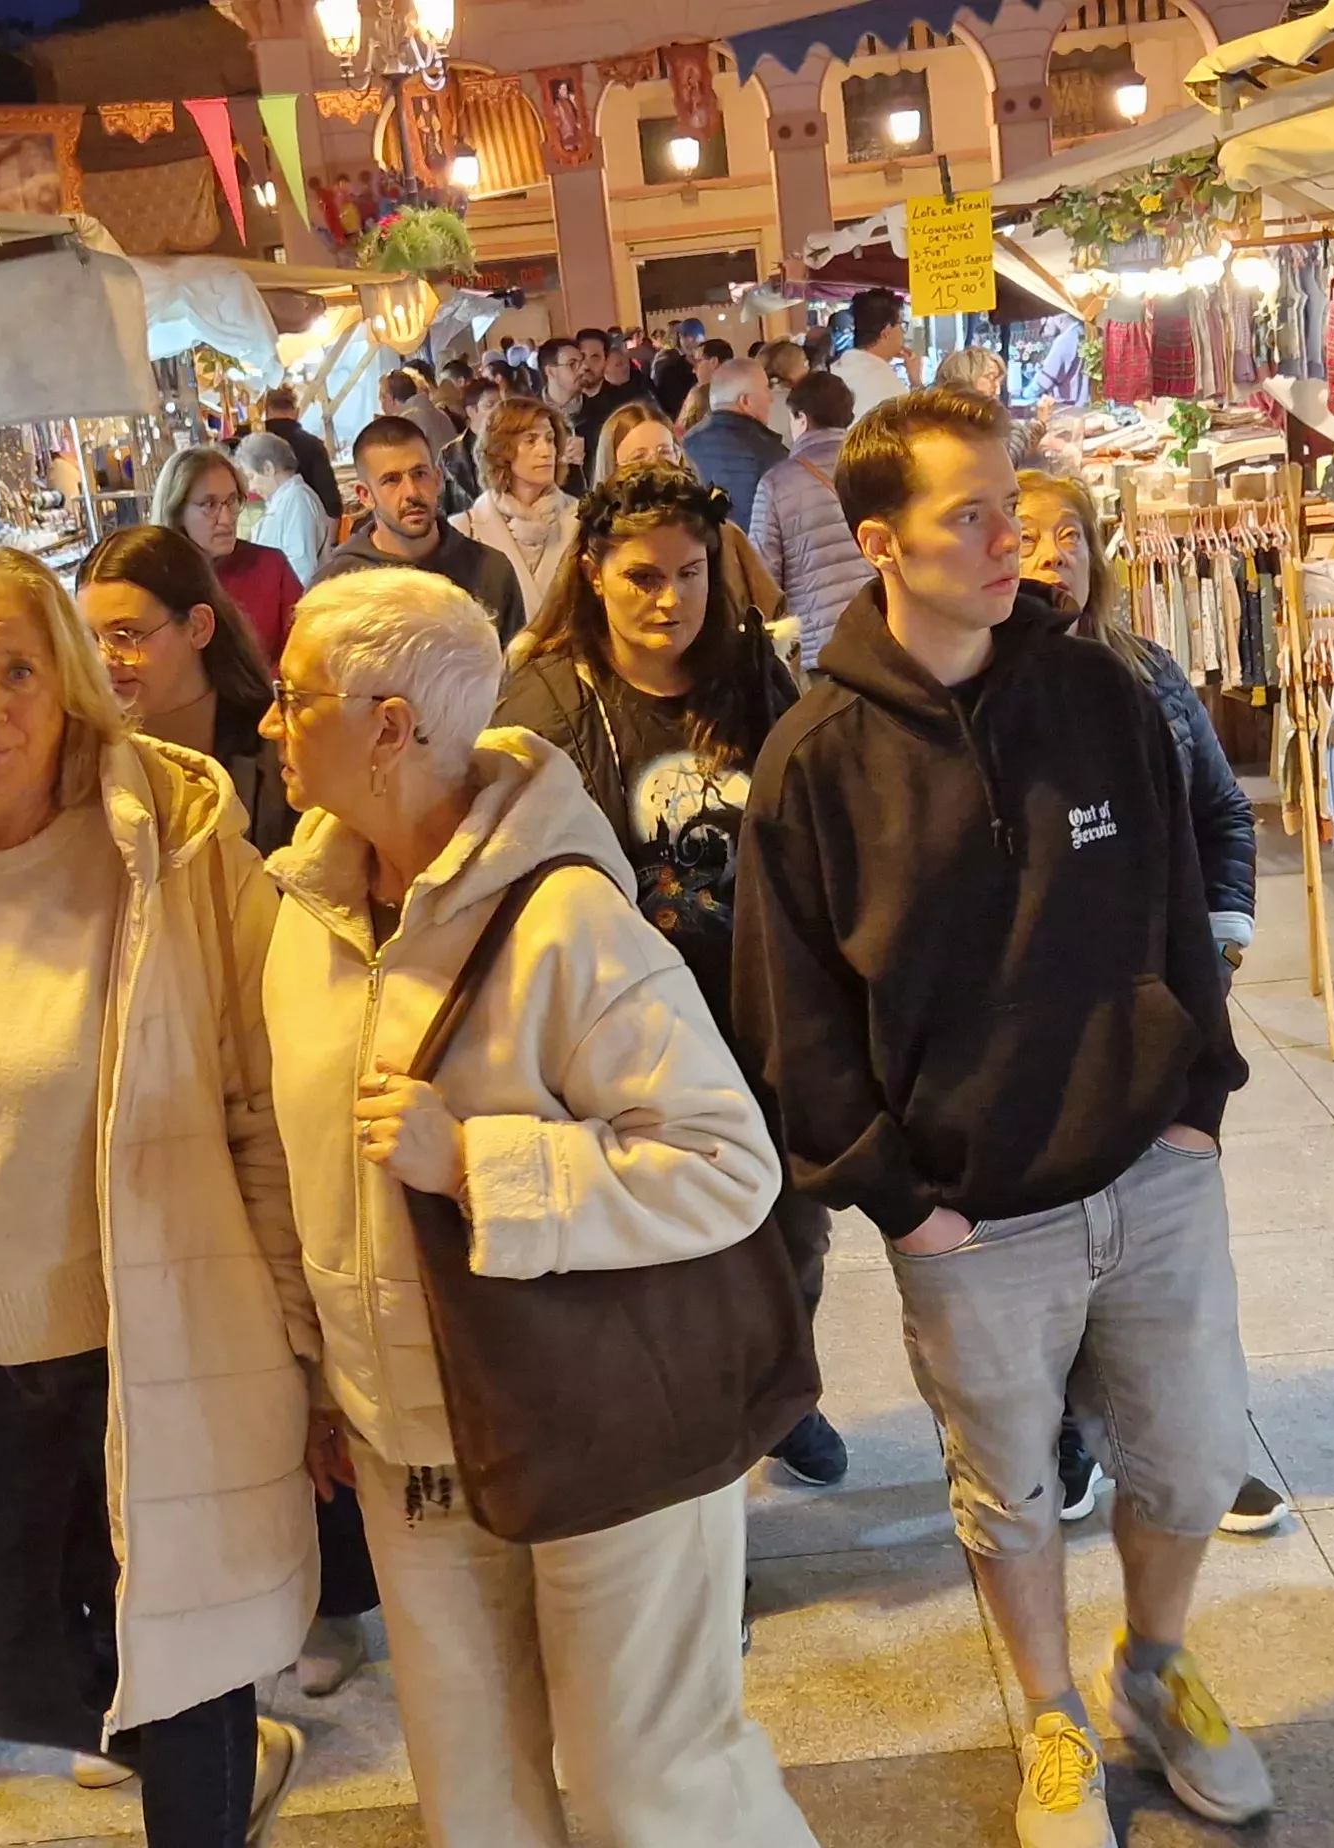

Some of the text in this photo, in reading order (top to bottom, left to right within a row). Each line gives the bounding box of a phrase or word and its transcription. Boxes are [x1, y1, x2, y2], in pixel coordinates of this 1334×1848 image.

[1068, 799, 1111, 827] Out of
[1070, 820, 1118, 850] Service
